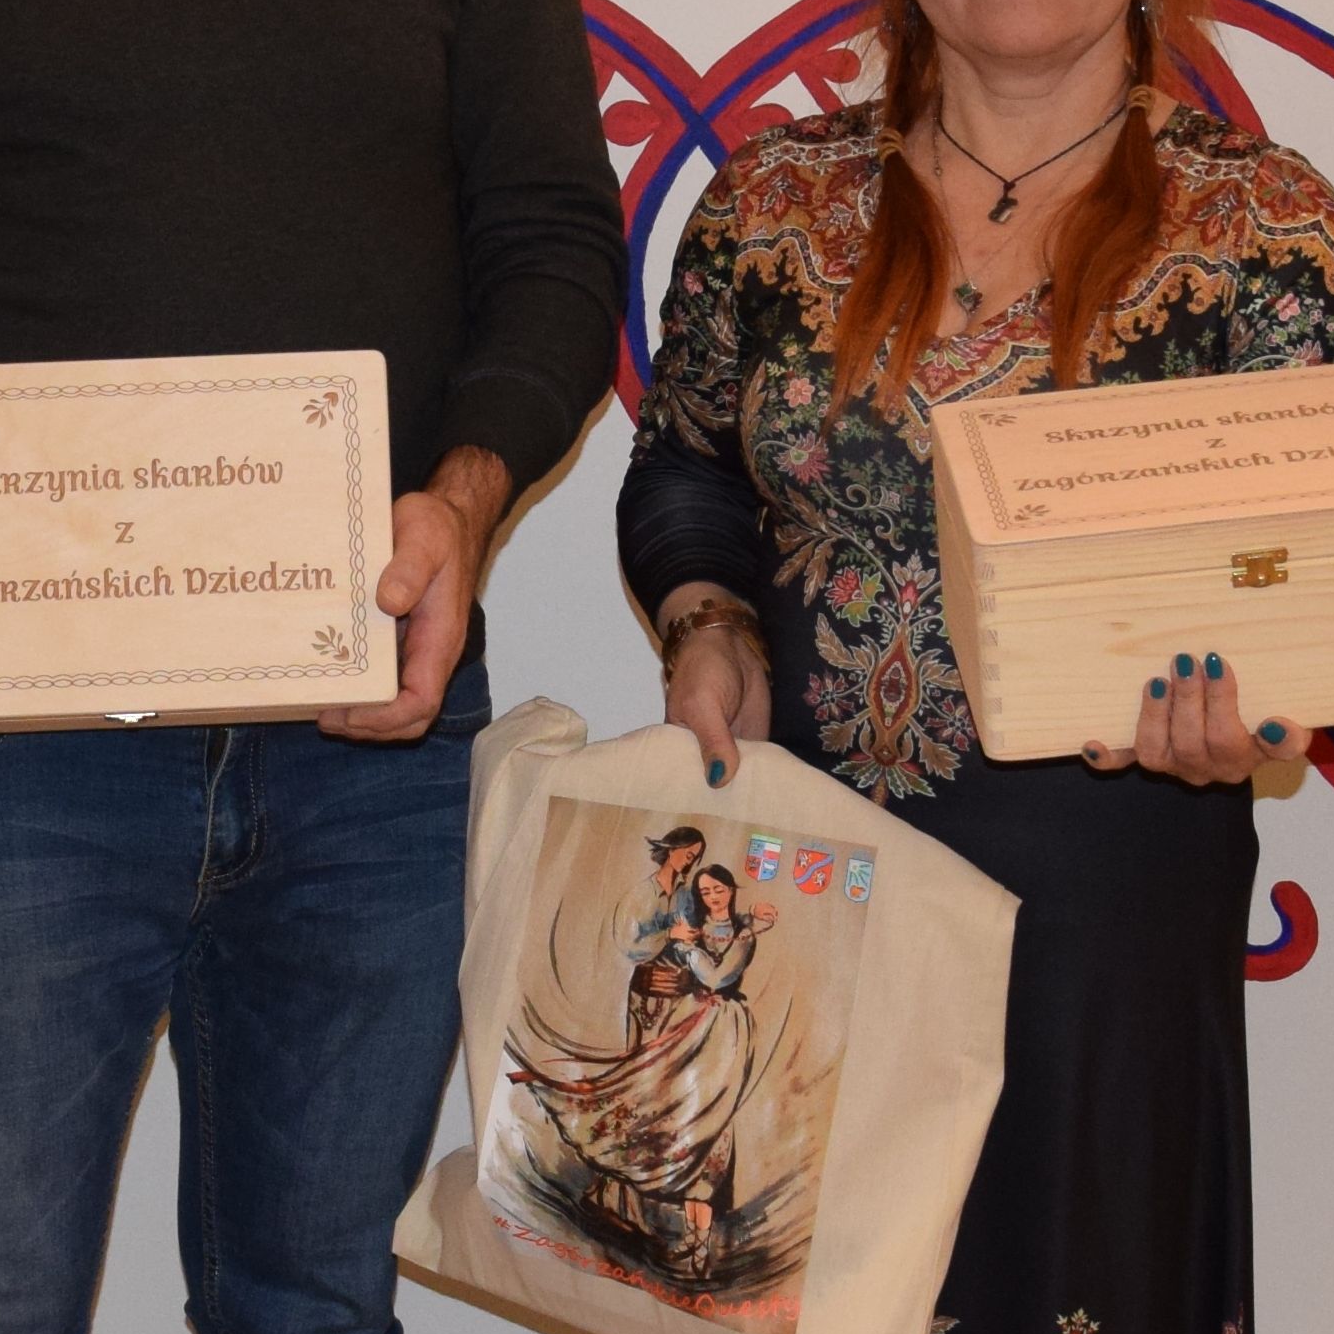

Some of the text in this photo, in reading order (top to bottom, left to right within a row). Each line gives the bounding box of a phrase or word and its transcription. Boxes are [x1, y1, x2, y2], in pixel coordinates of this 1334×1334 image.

[1045, 417, 1209, 444] Skrzynia
[132, 455, 284, 490] skarbów
[1014, 450, 1274, 492] Zagórzańskich
[114, 521, 135, 545] z
[182, 560, 336, 596] Dziedzin
